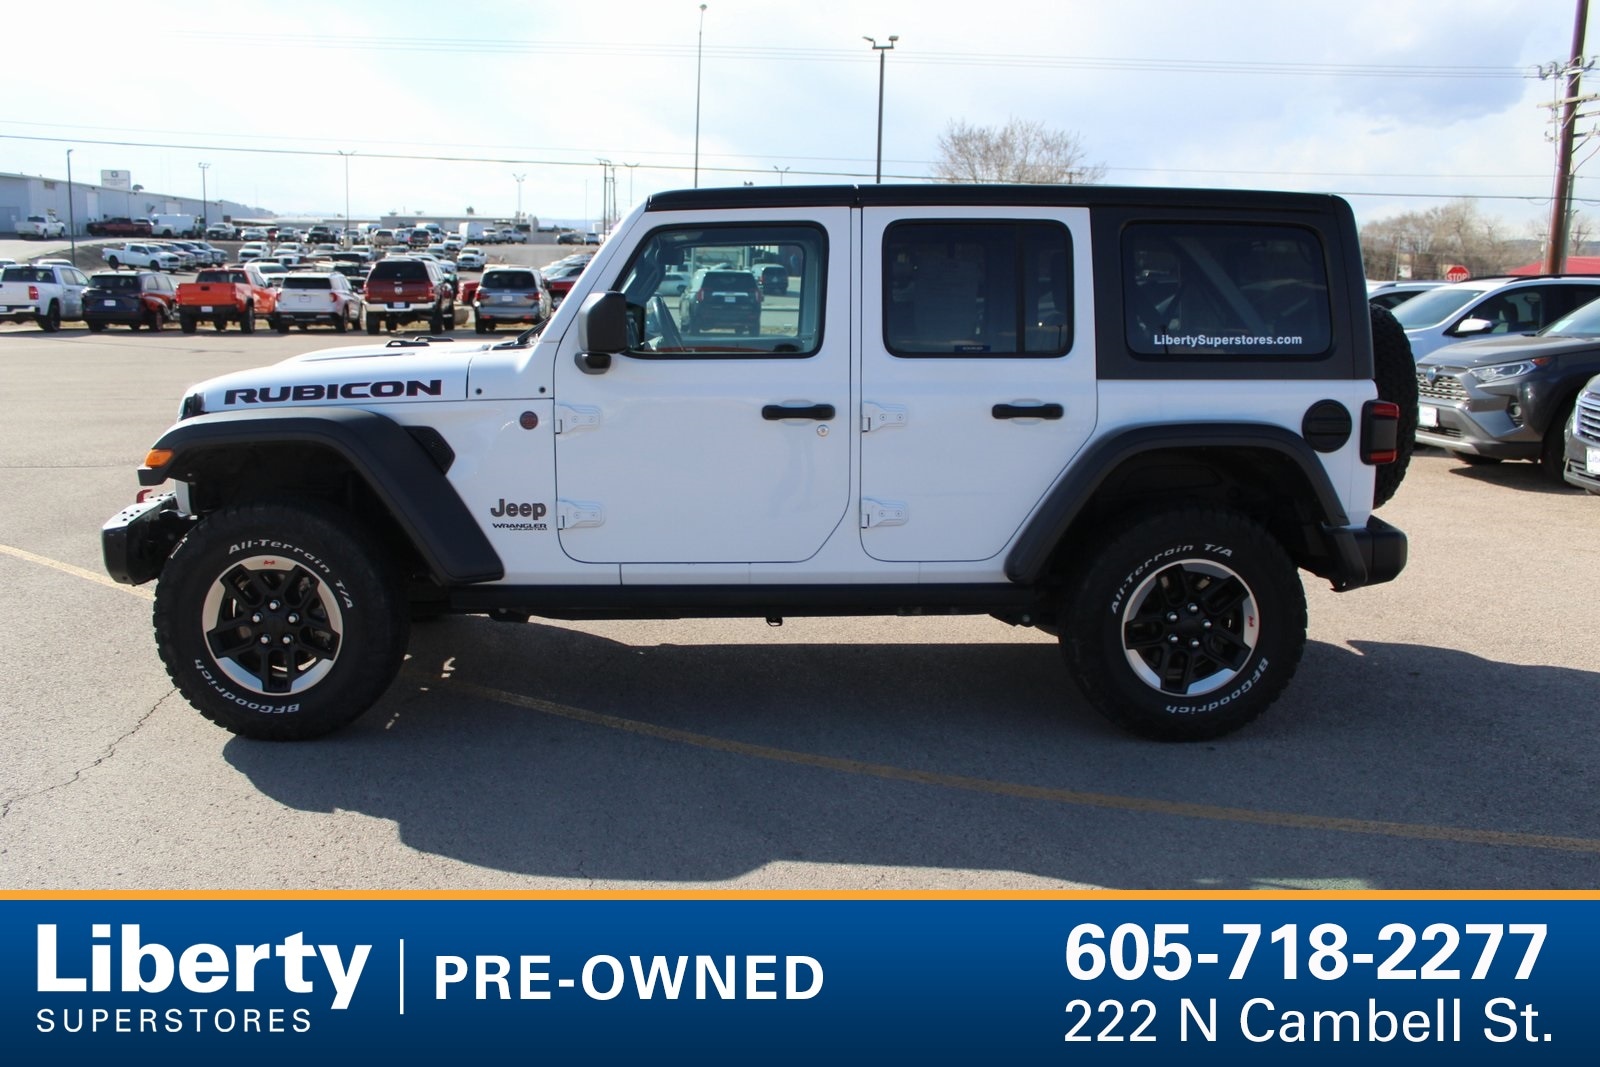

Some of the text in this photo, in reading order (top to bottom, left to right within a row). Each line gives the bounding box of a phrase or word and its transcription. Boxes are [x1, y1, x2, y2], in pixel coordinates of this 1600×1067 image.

[1447, 273, 1468, 282] STOP
[1154, 335, 1302, 347] LibertySuperstores.com
[224, 379, 442, 405] RUBICON
[490, 498, 547, 521] Jeep
[228, 538, 353, 609] All-Terrain T/A
[1110, 543, 1233, 614] All-Terrain T/A
[194, 658, 300, 714] BFGoodrich
[1165, 657, 1269, 715] BFGoodrich
